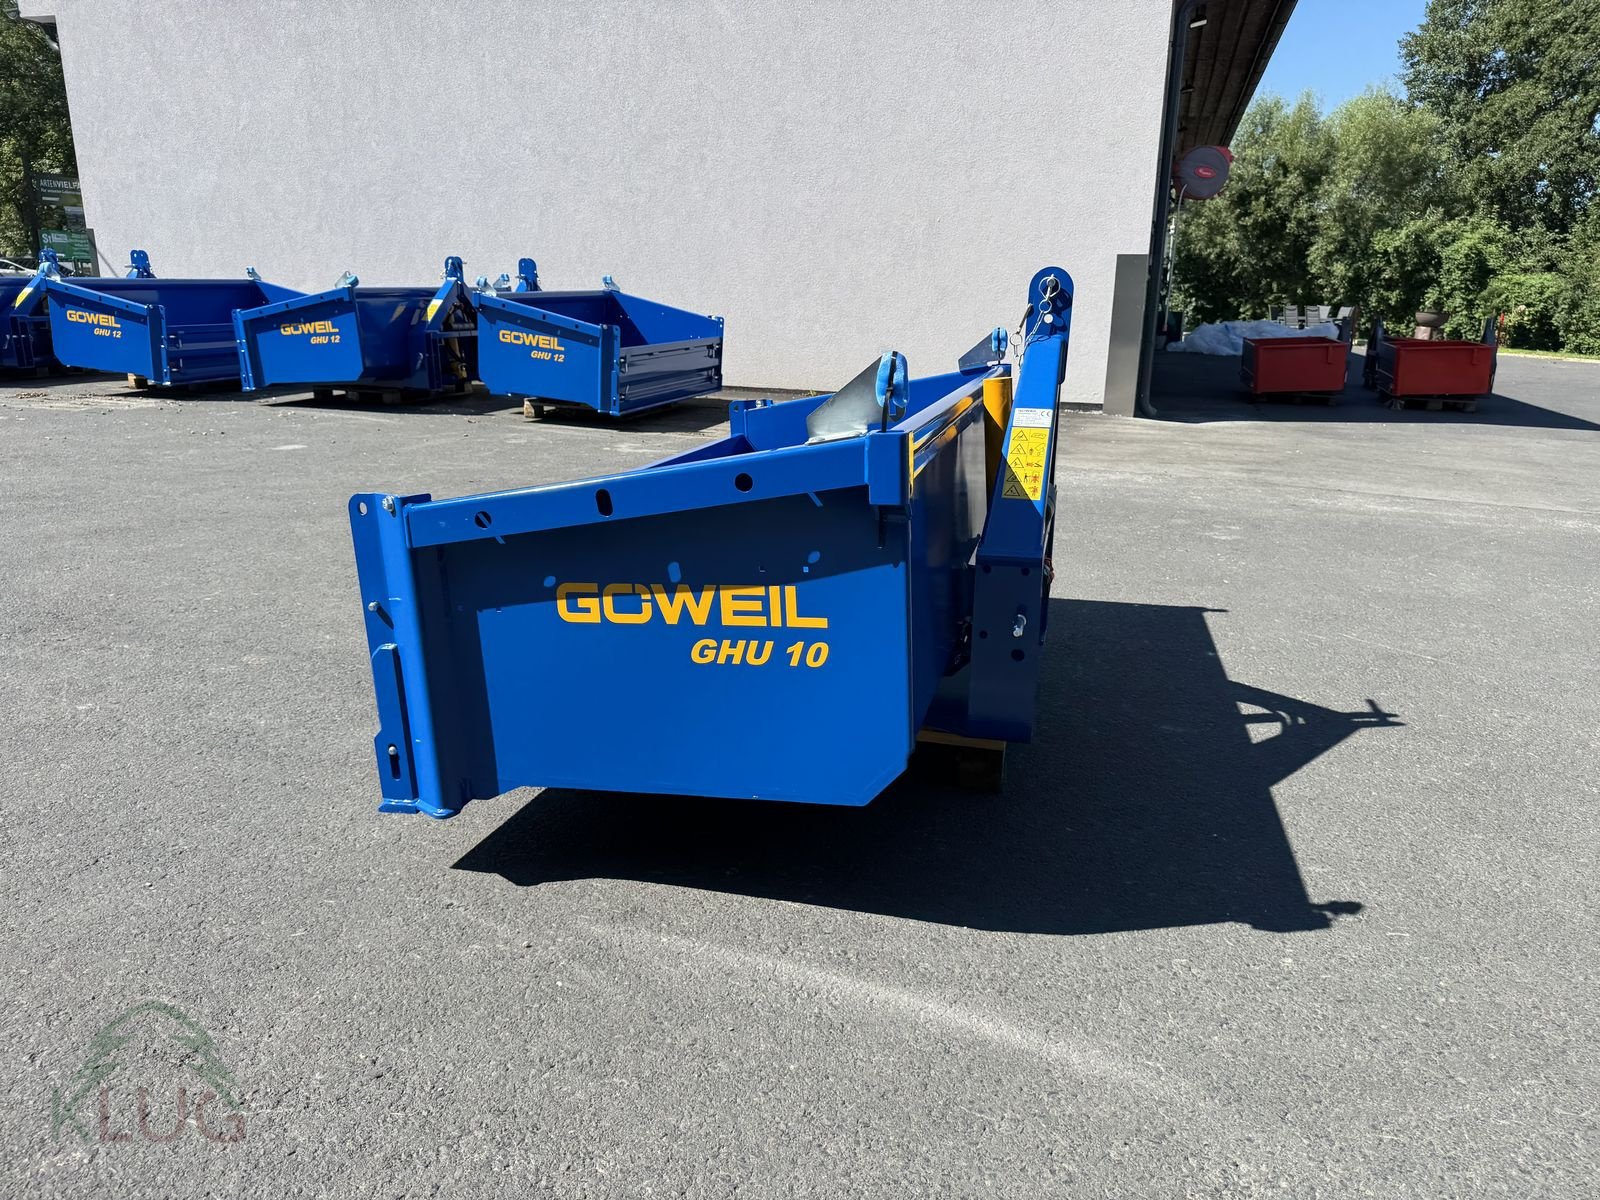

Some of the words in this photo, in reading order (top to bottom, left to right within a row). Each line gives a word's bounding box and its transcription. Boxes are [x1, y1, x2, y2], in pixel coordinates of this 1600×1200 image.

[94, 327, 111, 337] GHU
[112, 330, 122, 338] 12
[310, 335, 329, 345] GHU
[330, 334, 341, 344] 12
[530, 350, 552, 361] GHU
[553, 353, 565, 362] 12
[690, 638, 774, 666] GHU
[785, 641, 830, 668] 10
